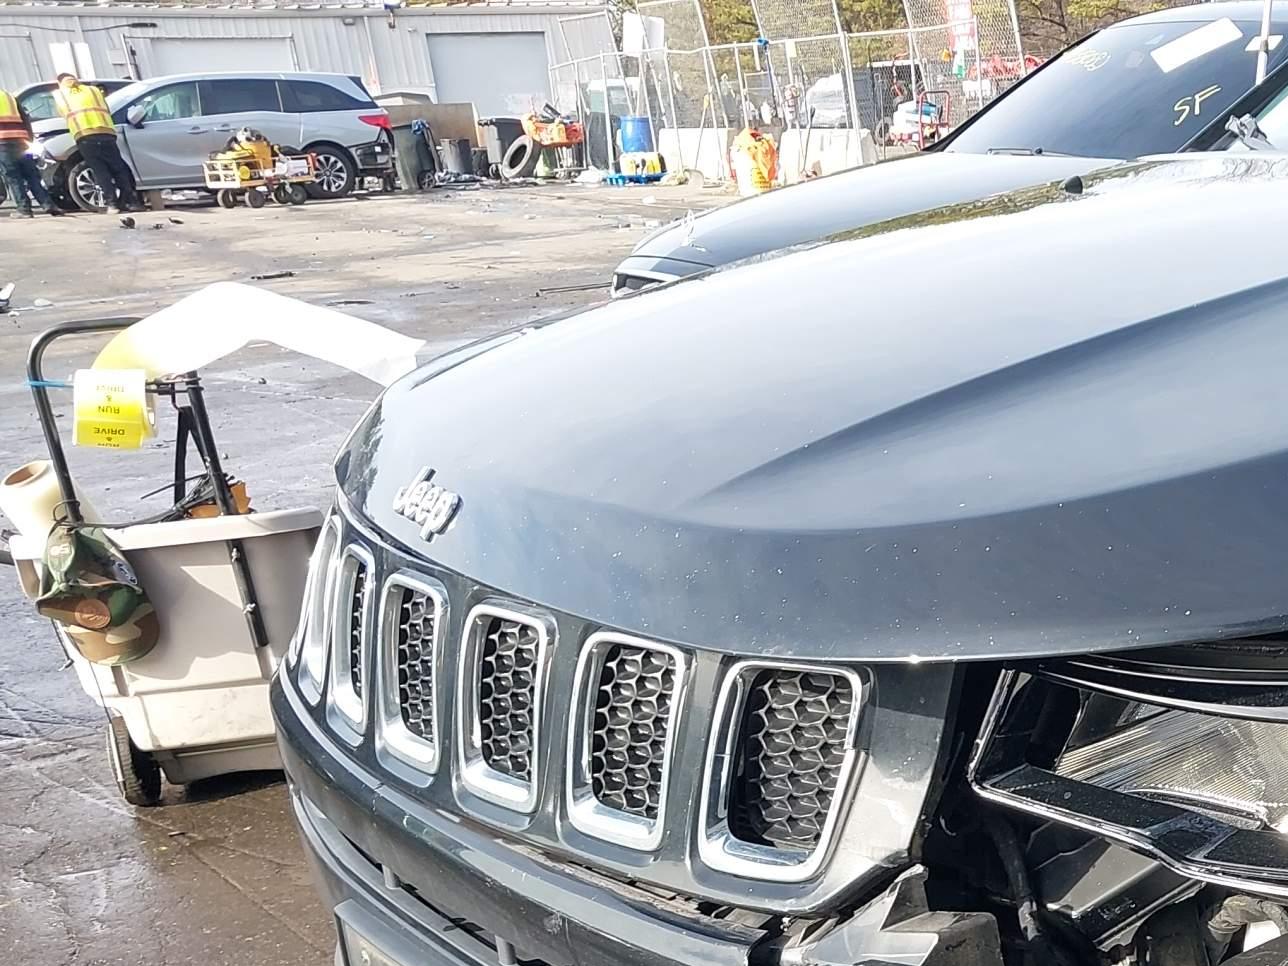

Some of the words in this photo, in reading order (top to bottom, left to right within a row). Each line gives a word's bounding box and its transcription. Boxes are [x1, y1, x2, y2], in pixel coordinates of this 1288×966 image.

[1173, 84, 1222, 127] SF
[98, 406, 120, 414] RUN
[94, 427, 125, 435] DRIVE
[392, 465, 464, 544] Jeep
